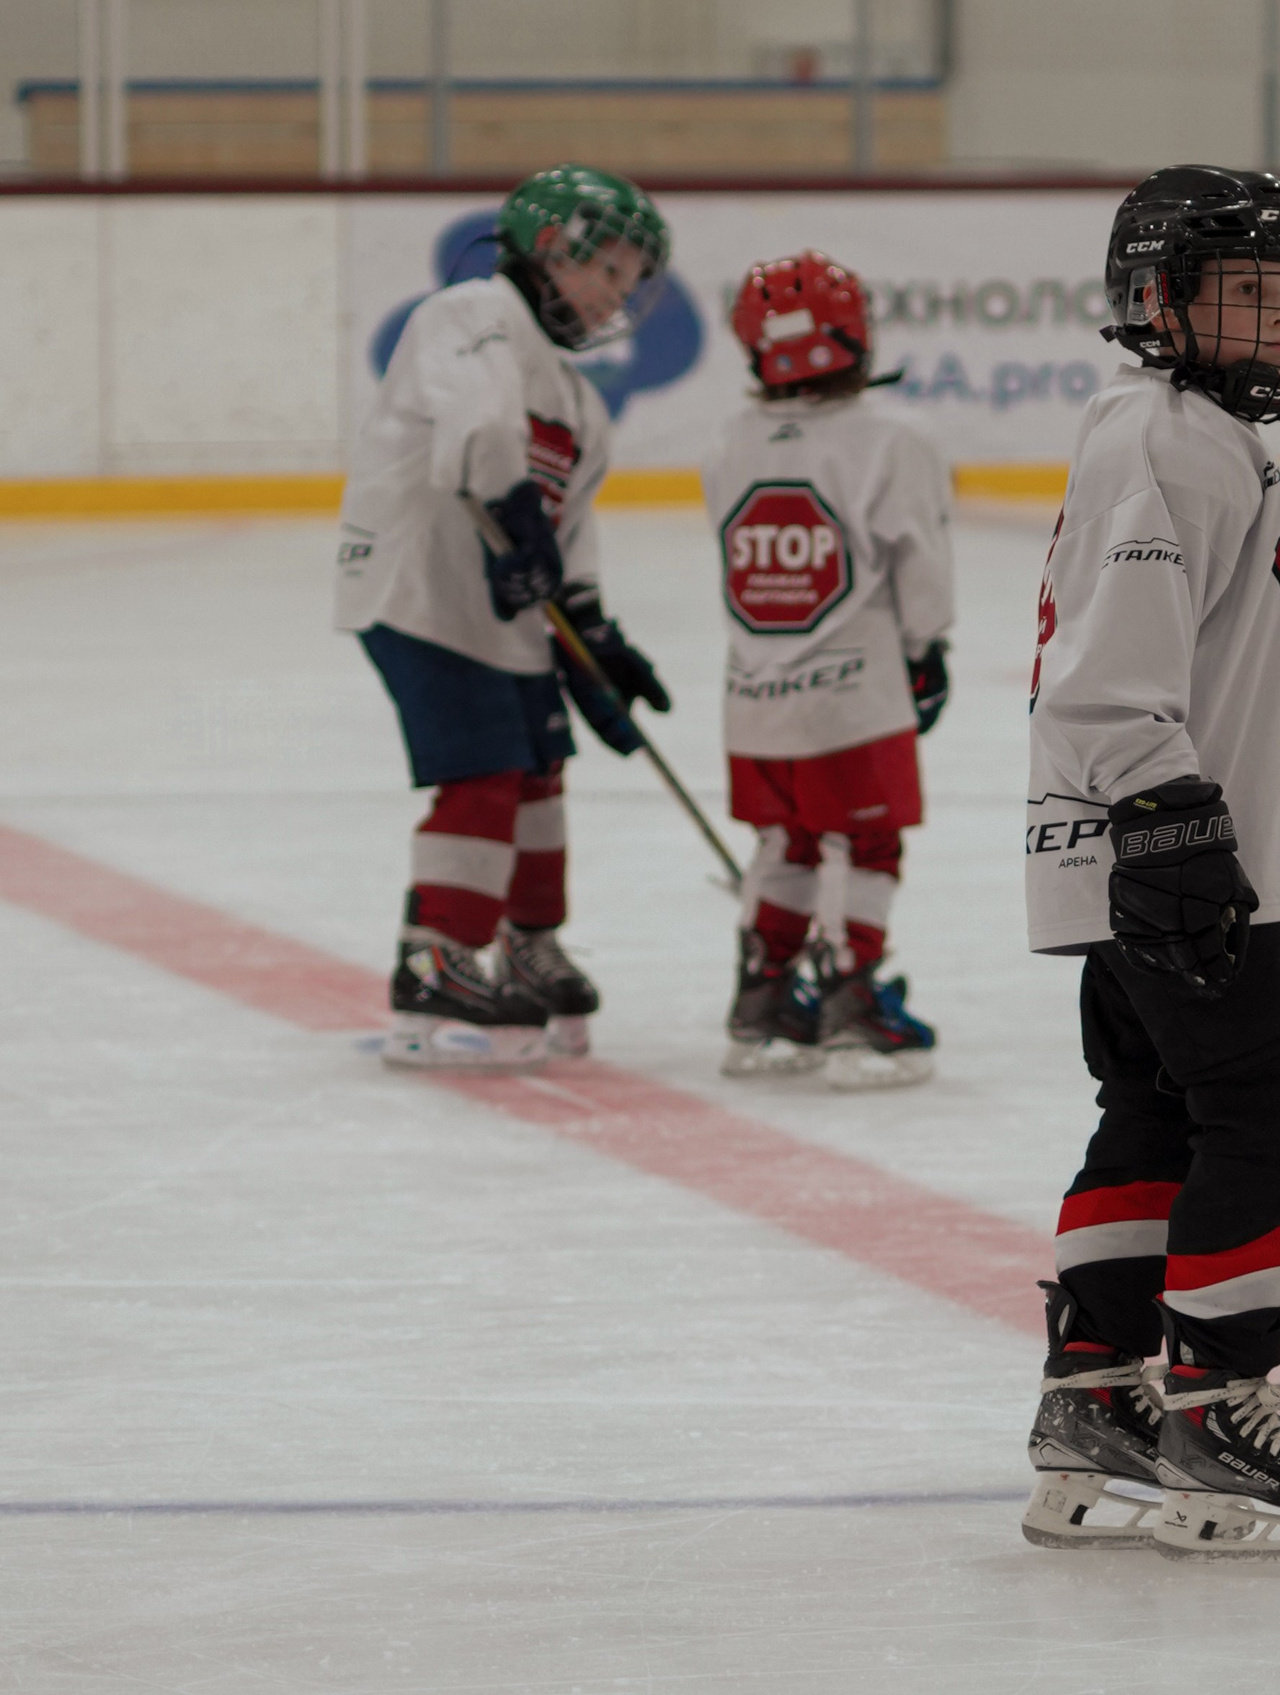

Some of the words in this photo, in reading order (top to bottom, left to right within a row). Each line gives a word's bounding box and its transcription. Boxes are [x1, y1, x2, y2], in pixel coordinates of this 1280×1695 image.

[1126, 240, 1164, 254] CCM
[1139, 339, 1161, 348] CCM
[733, 524, 836, 570] STOP
[1058, 855, 1098, 868] АРЕНА
